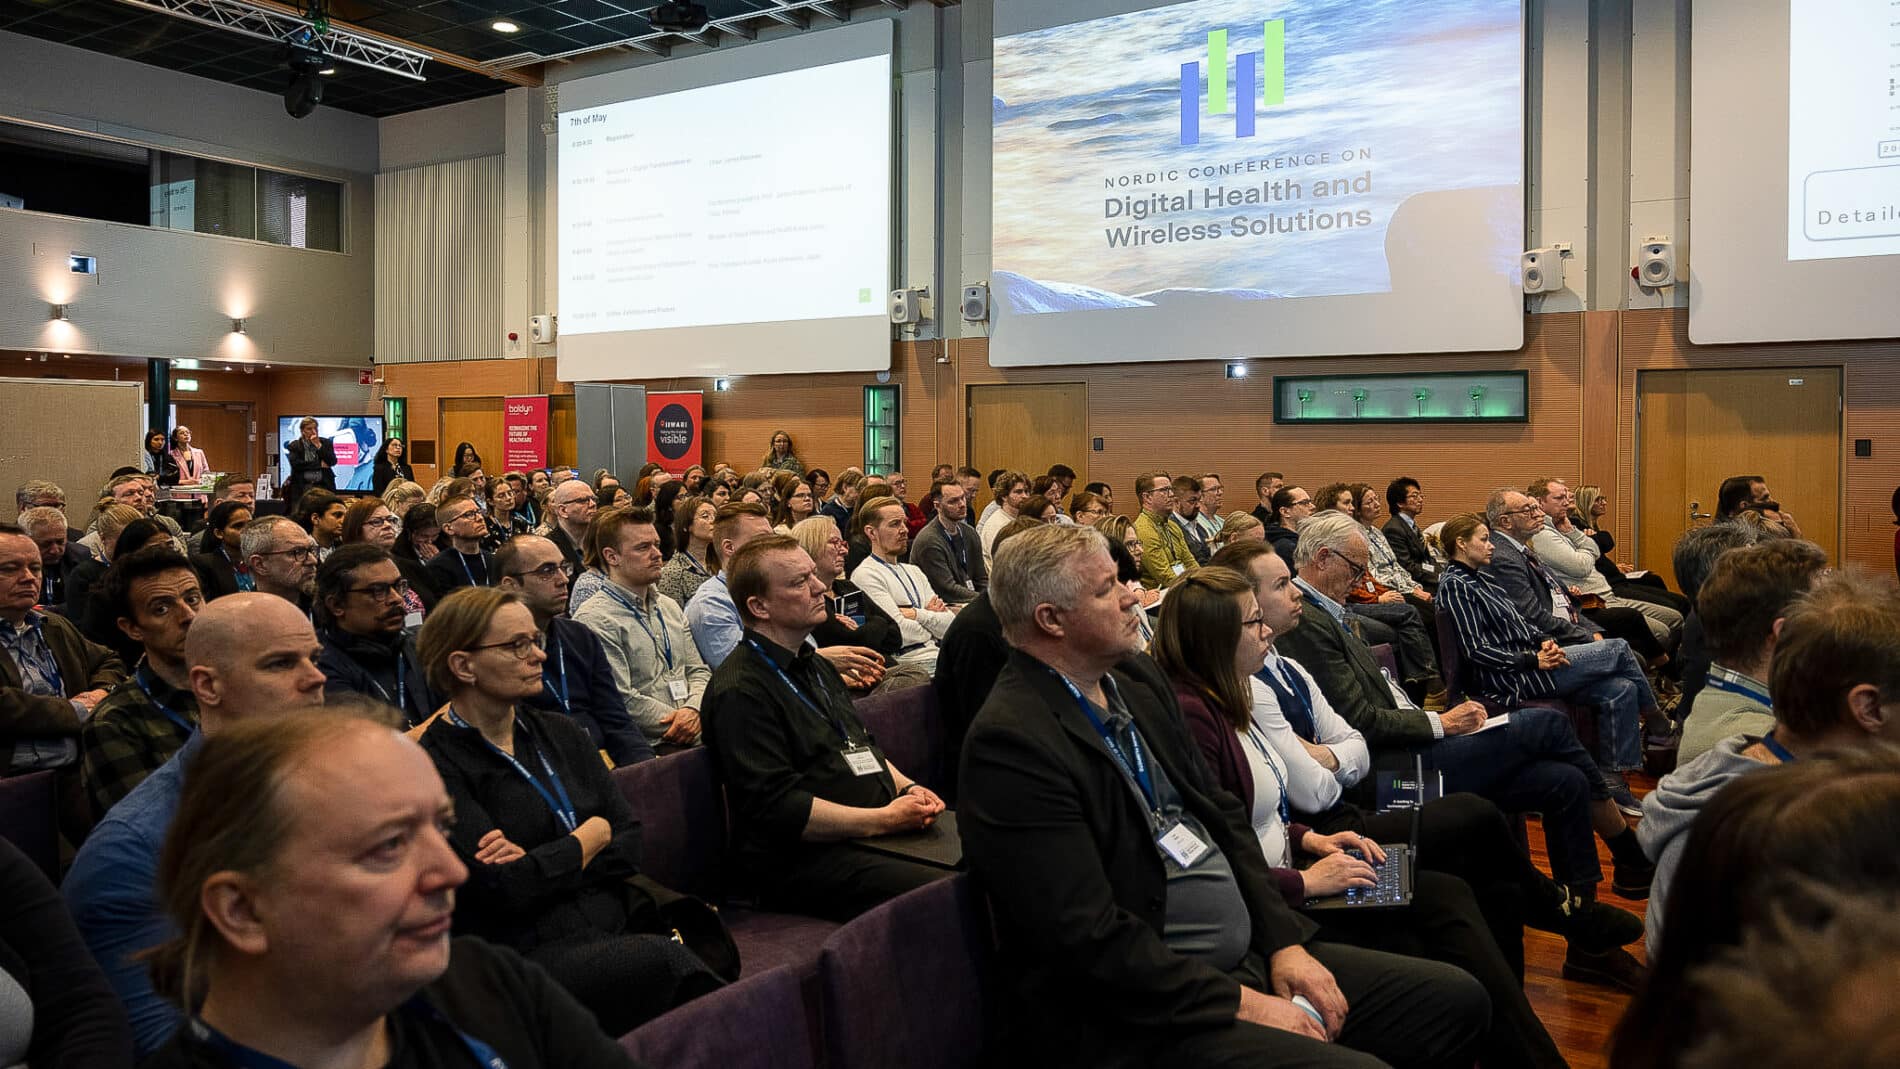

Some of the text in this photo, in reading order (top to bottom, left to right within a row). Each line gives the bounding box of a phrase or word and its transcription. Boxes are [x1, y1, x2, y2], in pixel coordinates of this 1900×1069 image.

[570, 114, 607, 127] 7th of May
[1104, 147, 1372, 189] NORDIC CONFERENCE ON
[1104, 170, 1372, 220] Digital Health and
[1818, 204, 1900, 225] Detail
[1105, 208, 1372, 249] Wireless Solutions
[508, 404, 534, 416] boldyn
[660, 433, 688, 444] visible
